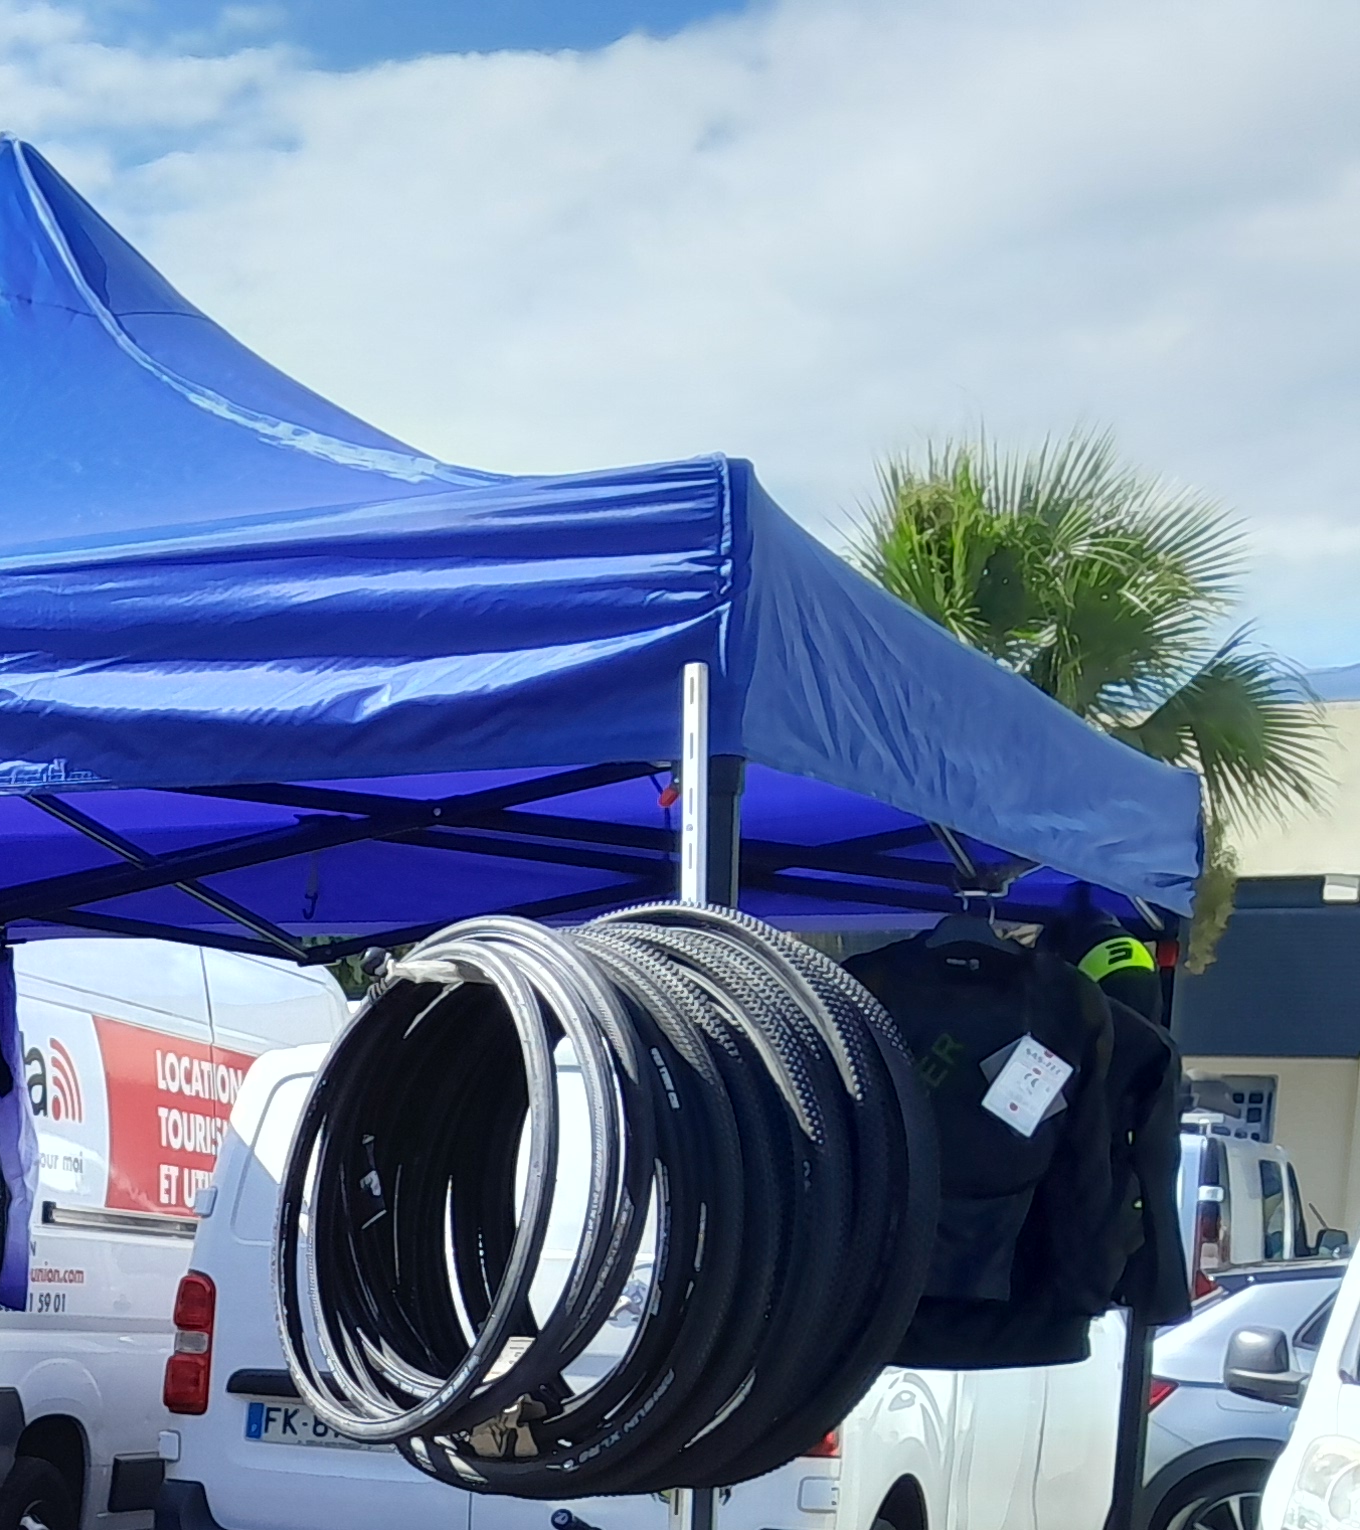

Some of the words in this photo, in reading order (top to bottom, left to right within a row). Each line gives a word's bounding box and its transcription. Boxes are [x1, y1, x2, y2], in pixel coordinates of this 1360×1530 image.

[156, 1049, 243, 1105] LOCATION
[157, 1106, 228, 1156] TOURIS
[159, 1163, 179, 1205] ET
[30, 1261, 84, 1284] union.com
